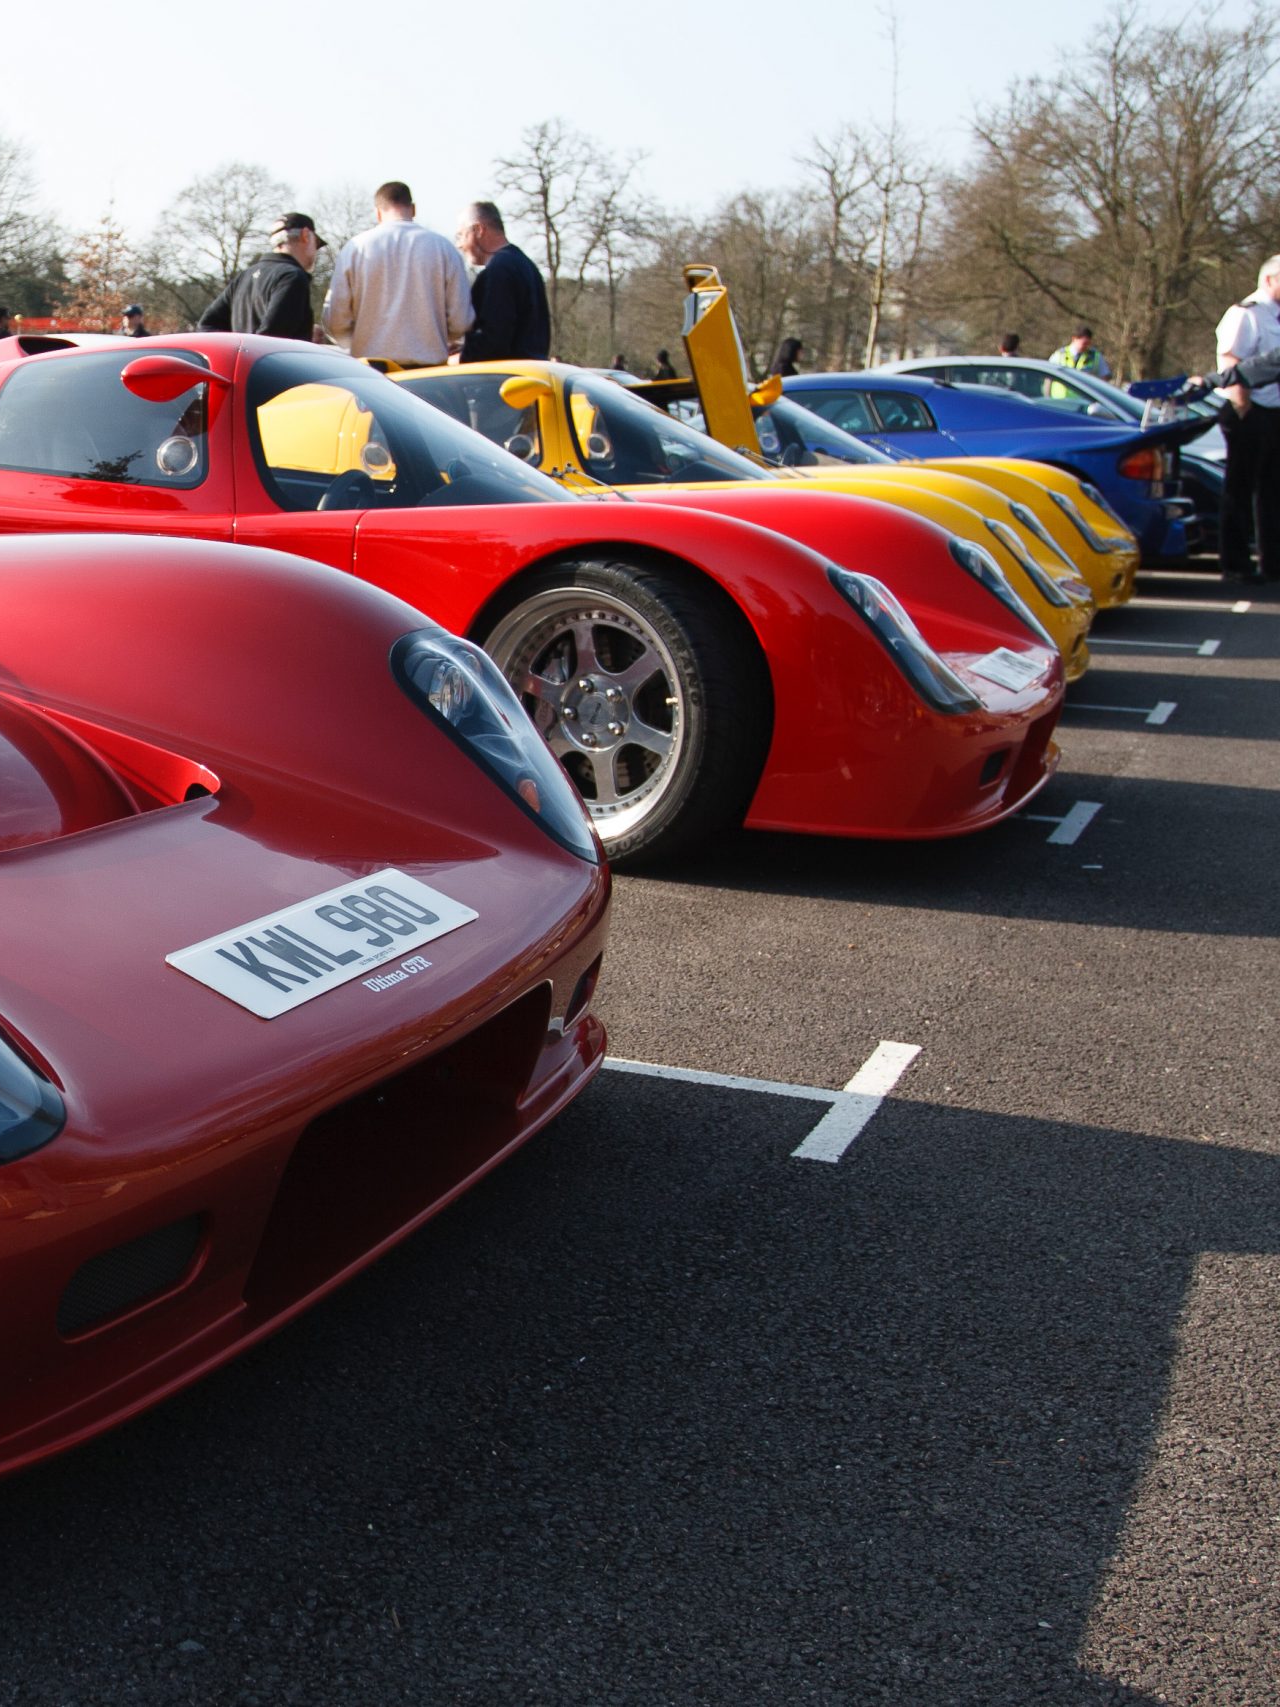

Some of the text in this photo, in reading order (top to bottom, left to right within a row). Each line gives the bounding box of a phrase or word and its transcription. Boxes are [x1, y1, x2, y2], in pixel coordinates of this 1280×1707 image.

[214, 885, 440, 993] KWL 980
[361, 955, 433, 992] Ultima GTR
